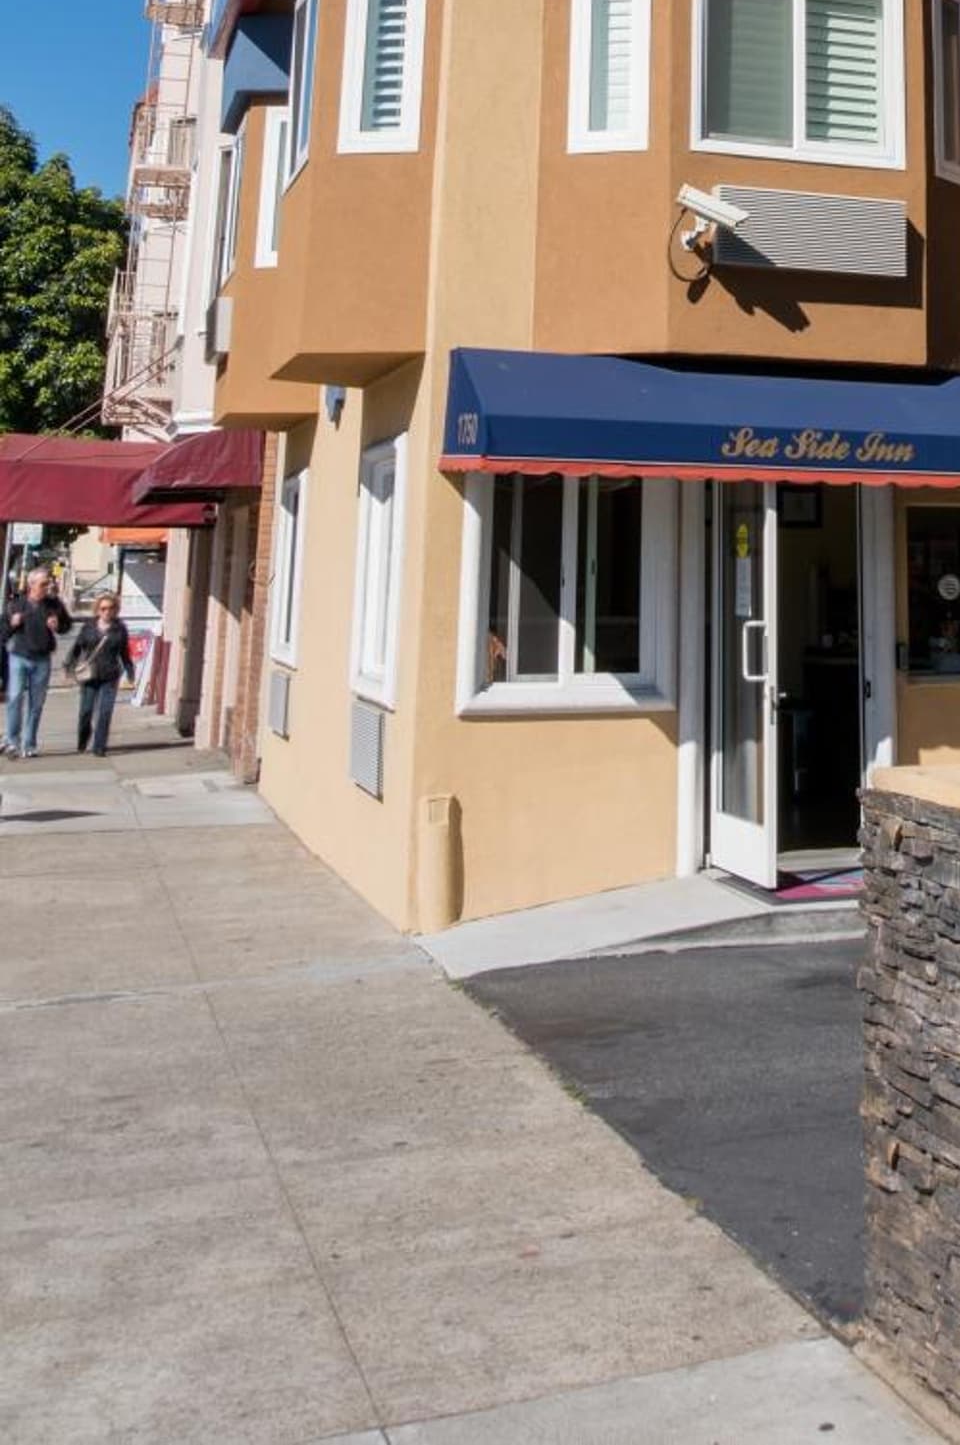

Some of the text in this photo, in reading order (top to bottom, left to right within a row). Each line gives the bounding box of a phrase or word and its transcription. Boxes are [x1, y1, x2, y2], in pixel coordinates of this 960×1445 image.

[721, 427, 916, 463] Sea Side Inn
